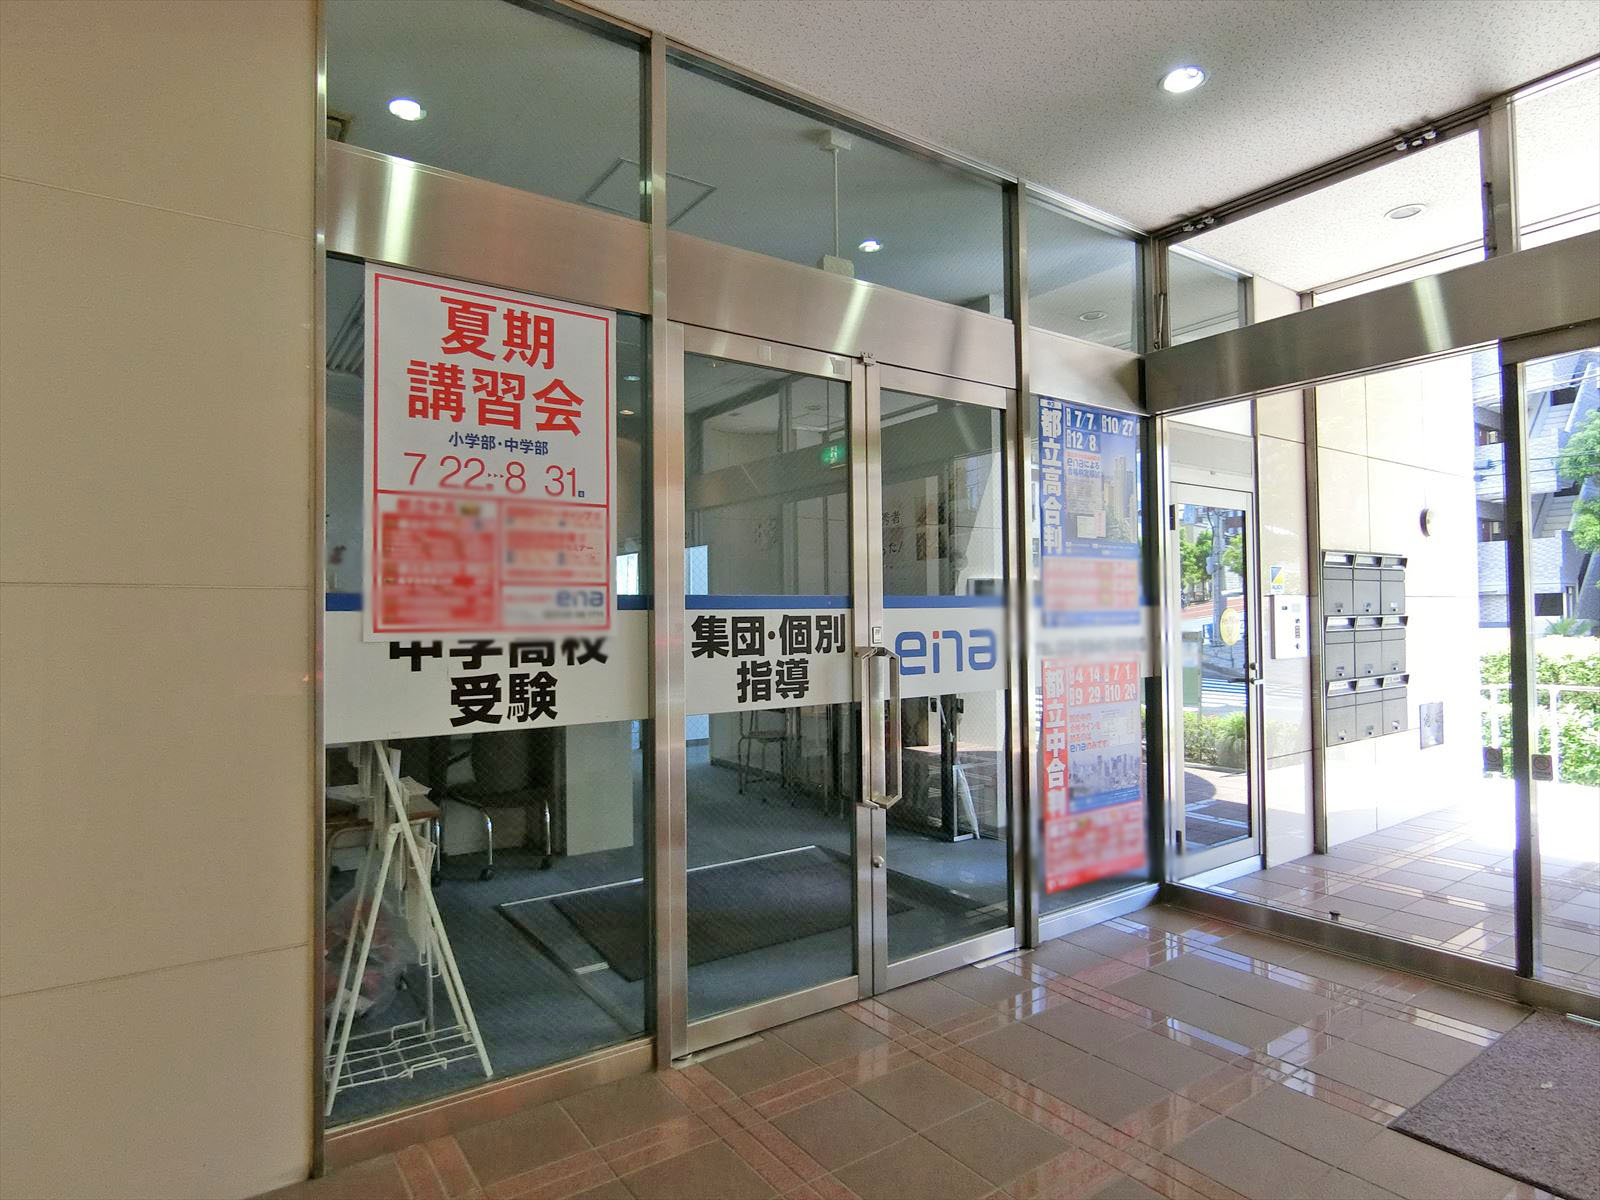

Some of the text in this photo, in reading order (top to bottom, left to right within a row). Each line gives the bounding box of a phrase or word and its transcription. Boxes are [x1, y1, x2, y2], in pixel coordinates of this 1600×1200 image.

[440, 296, 555, 370] 夏期
[407, 359, 585, 437] 講習会
[449, 431, 549, 456] 小学部・中学部
[691, 613, 846, 659] 集団・個別
[450, 671, 559, 727] 受験
[737, 658, 810, 703] 指導
